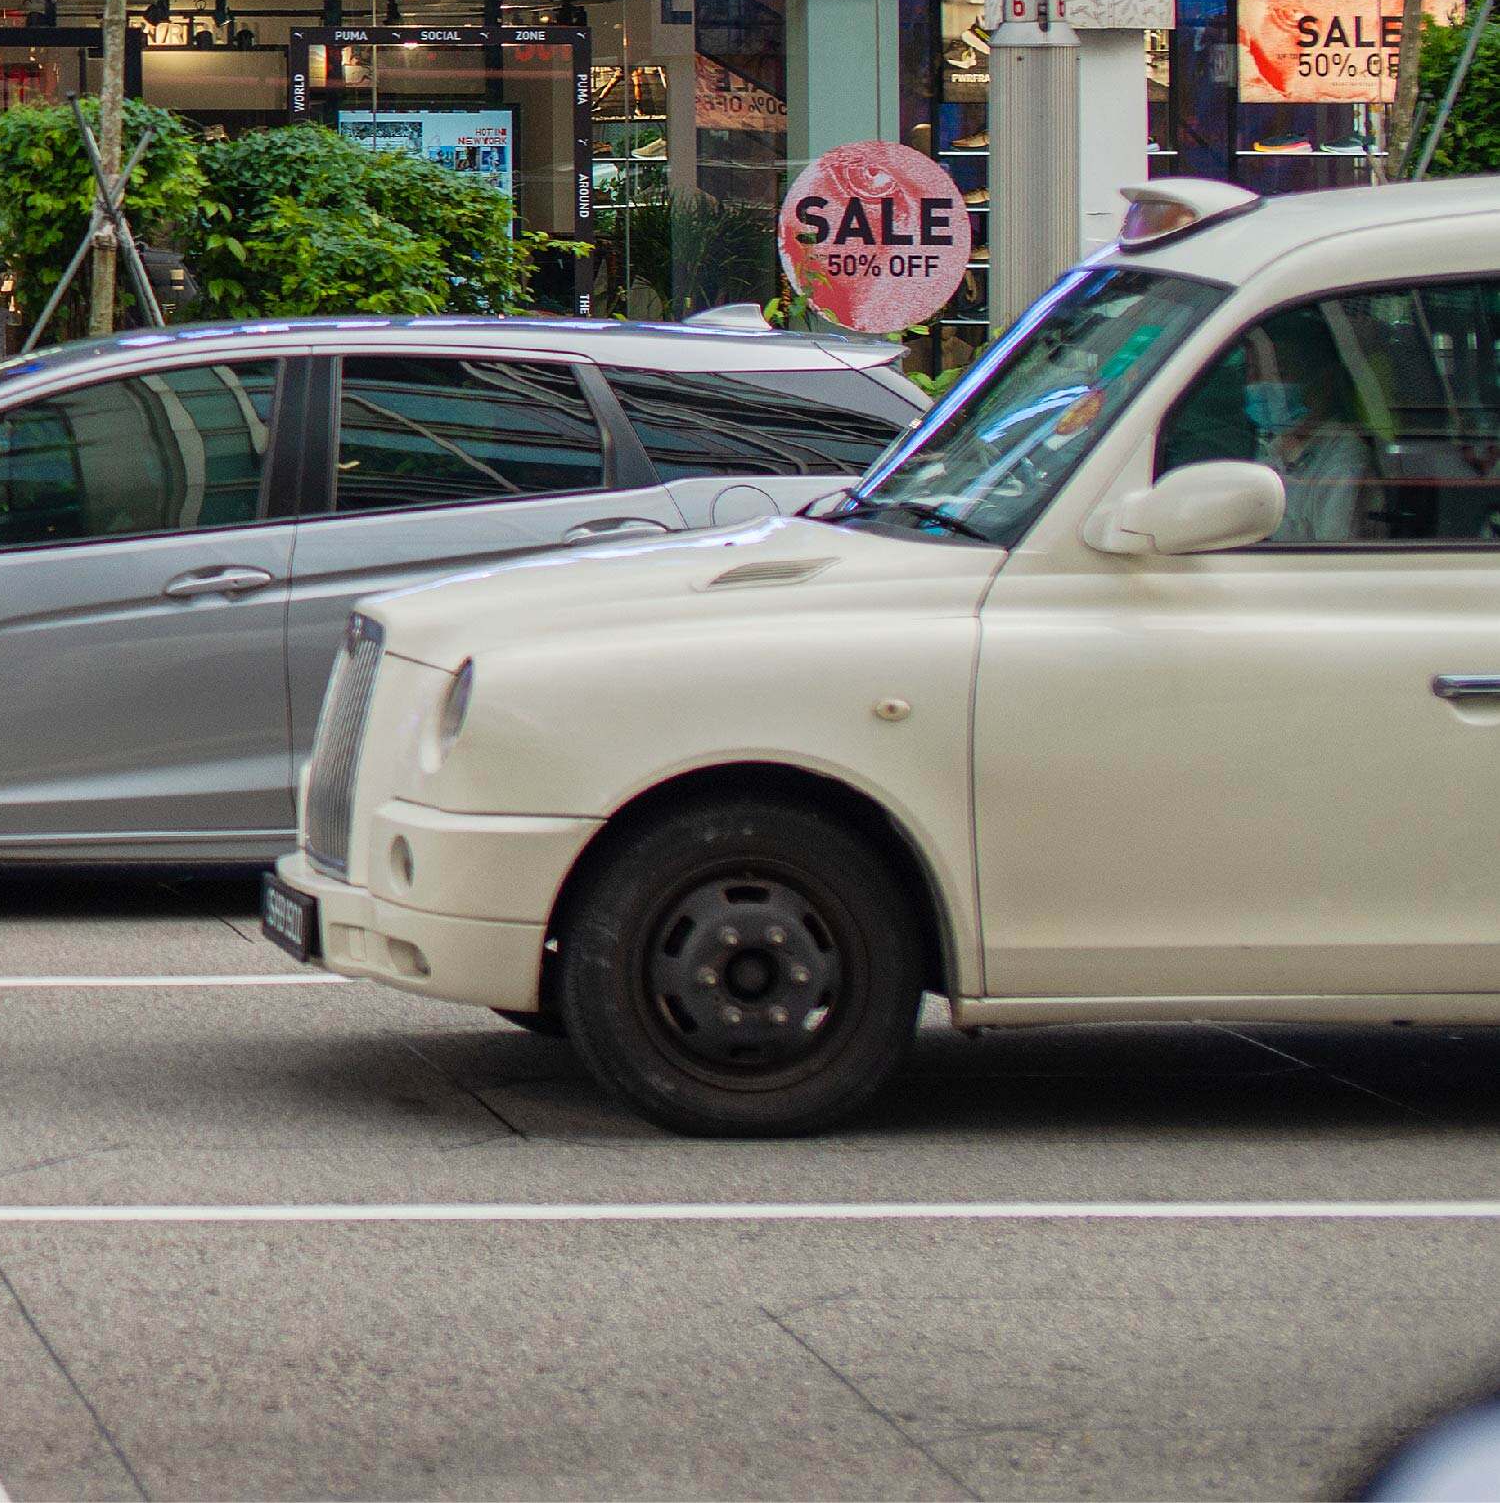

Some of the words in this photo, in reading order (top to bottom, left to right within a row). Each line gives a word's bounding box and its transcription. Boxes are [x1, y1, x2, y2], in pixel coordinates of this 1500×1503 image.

[335, 31, 368, 41] PUMA
[421, 31, 461, 41] SOCIAL
[516, 31, 545, 41] ZONE
[1298, 15, 1401, 48] SALE
[1299, 53, 1358, 78] 50%
[1366, 53, 1401, 78] OF
[293, 73, 306, 113] WORLD
[576, 74, 589, 106] PUMA
[579, 173, 591, 218] AROUND
[795, 195, 954, 246] SALE
[828, 254, 881, 278] 50%
[889, 255, 940, 278] OFF
